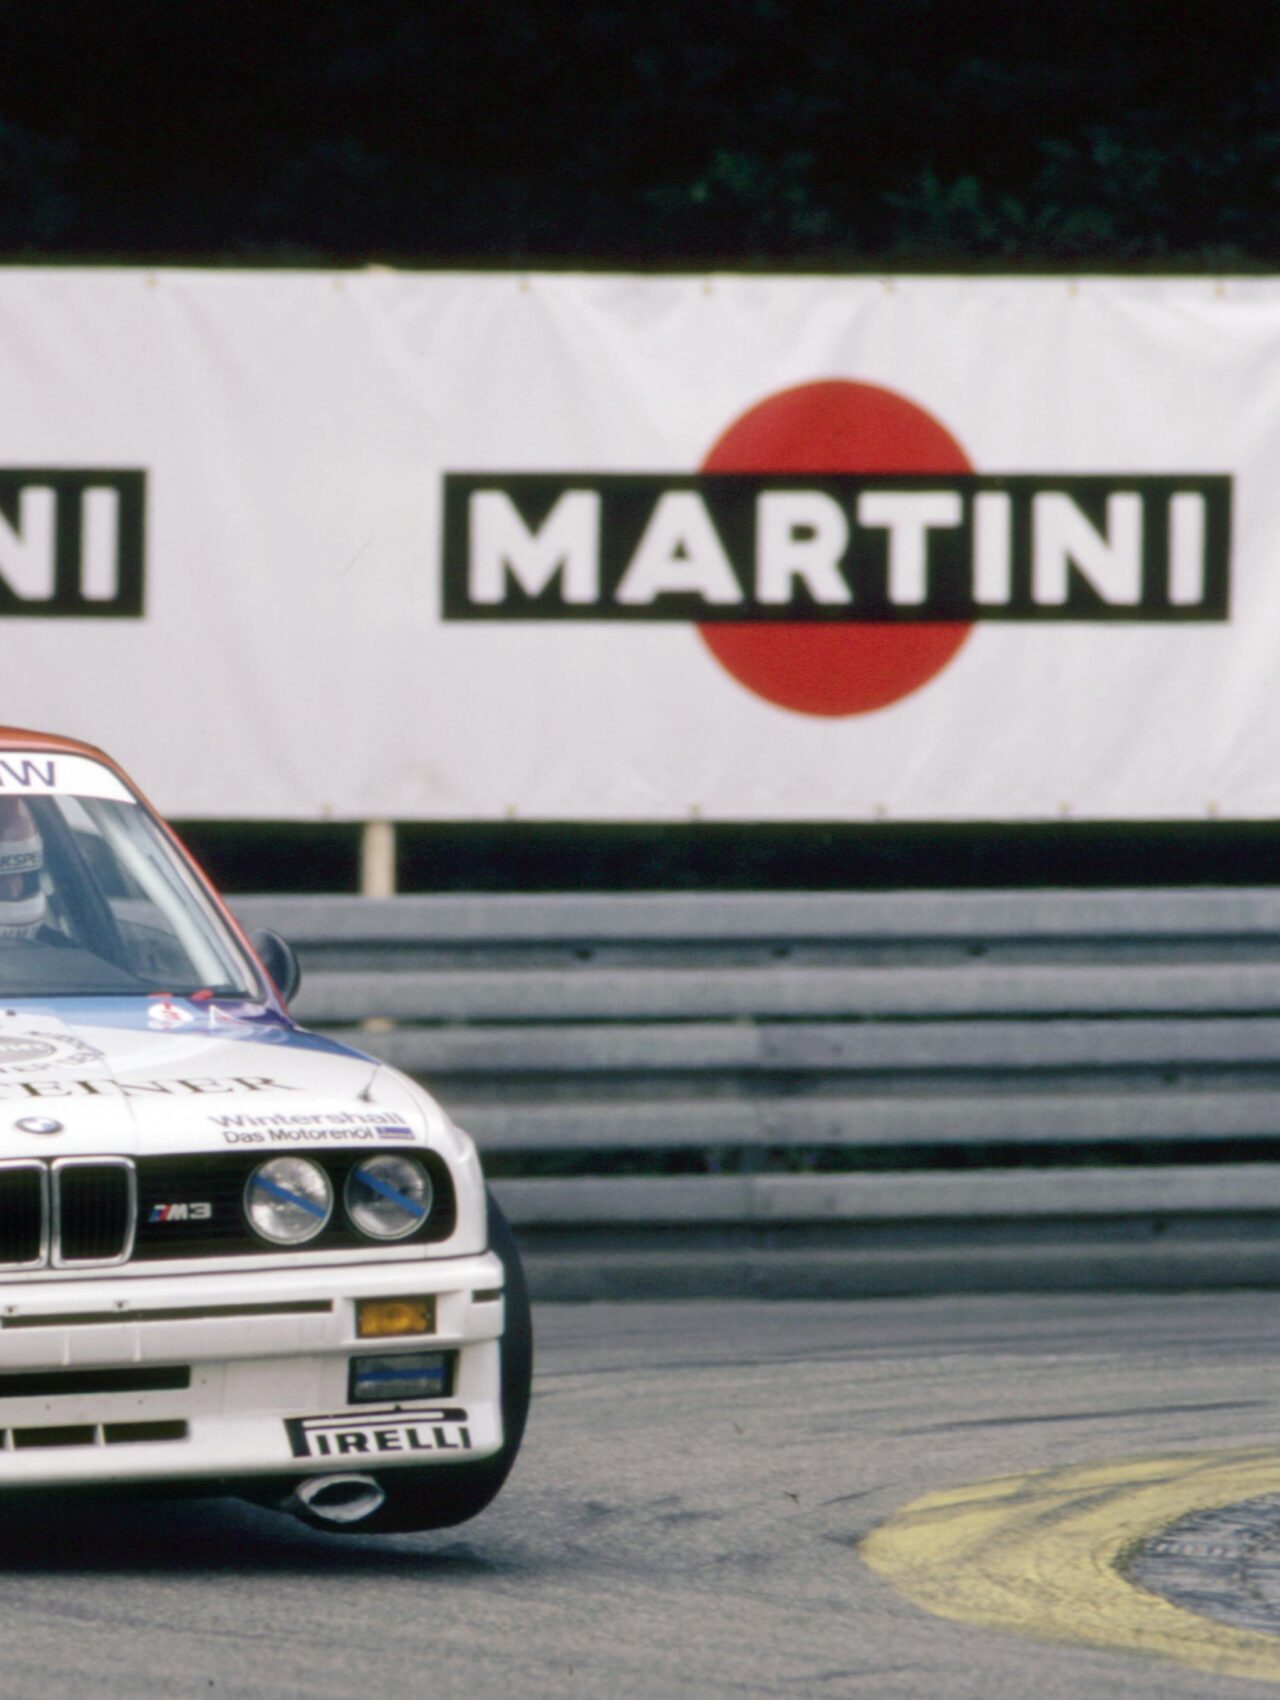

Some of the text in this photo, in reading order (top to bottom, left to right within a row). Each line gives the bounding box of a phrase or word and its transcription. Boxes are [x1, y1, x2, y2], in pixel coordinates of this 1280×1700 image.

[468, 489, 1206, 607] MARTINI
[205, 1111, 408, 1128] Wintershall
[222, 1129, 265, 1144] Das
[283, 1406, 472, 1459] PIRELLI
